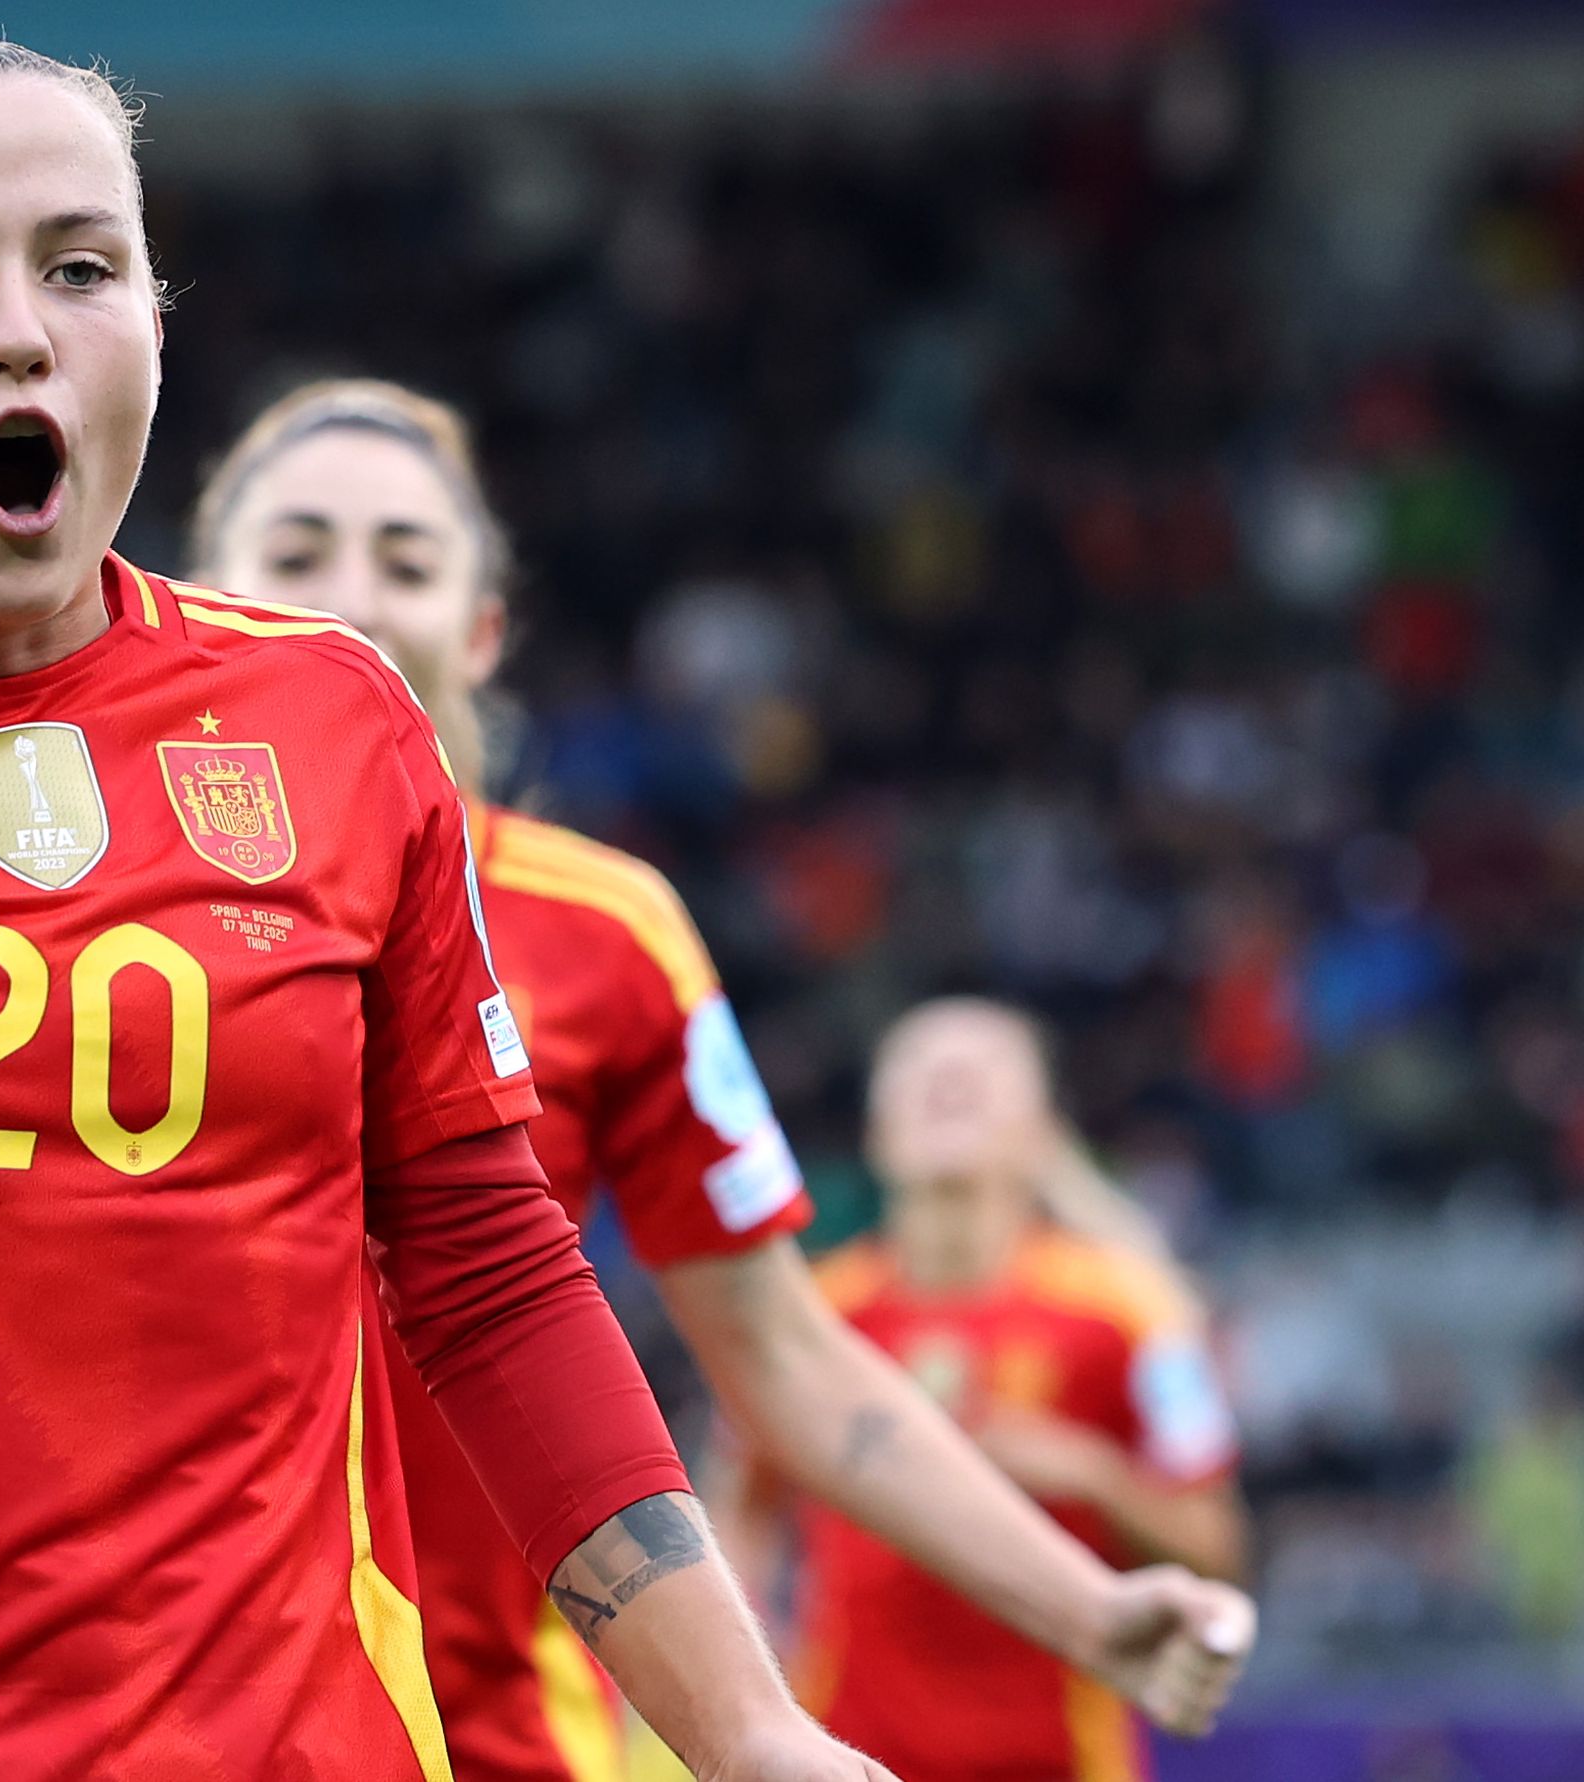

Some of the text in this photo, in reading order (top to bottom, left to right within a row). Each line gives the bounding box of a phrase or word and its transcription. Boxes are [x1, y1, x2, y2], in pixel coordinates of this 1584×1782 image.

[16, 827, 76, 850] FIFA
[8, 849, 40, 860] WORLD
[33, 857, 67, 872] 2023
[209, 904, 242, 919] SPAIN
[252, 909, 294, 931] BELGIUM
[222, 919, 288, 943] 07 JULY 2025
[245, 935, 272, 953] THUN
